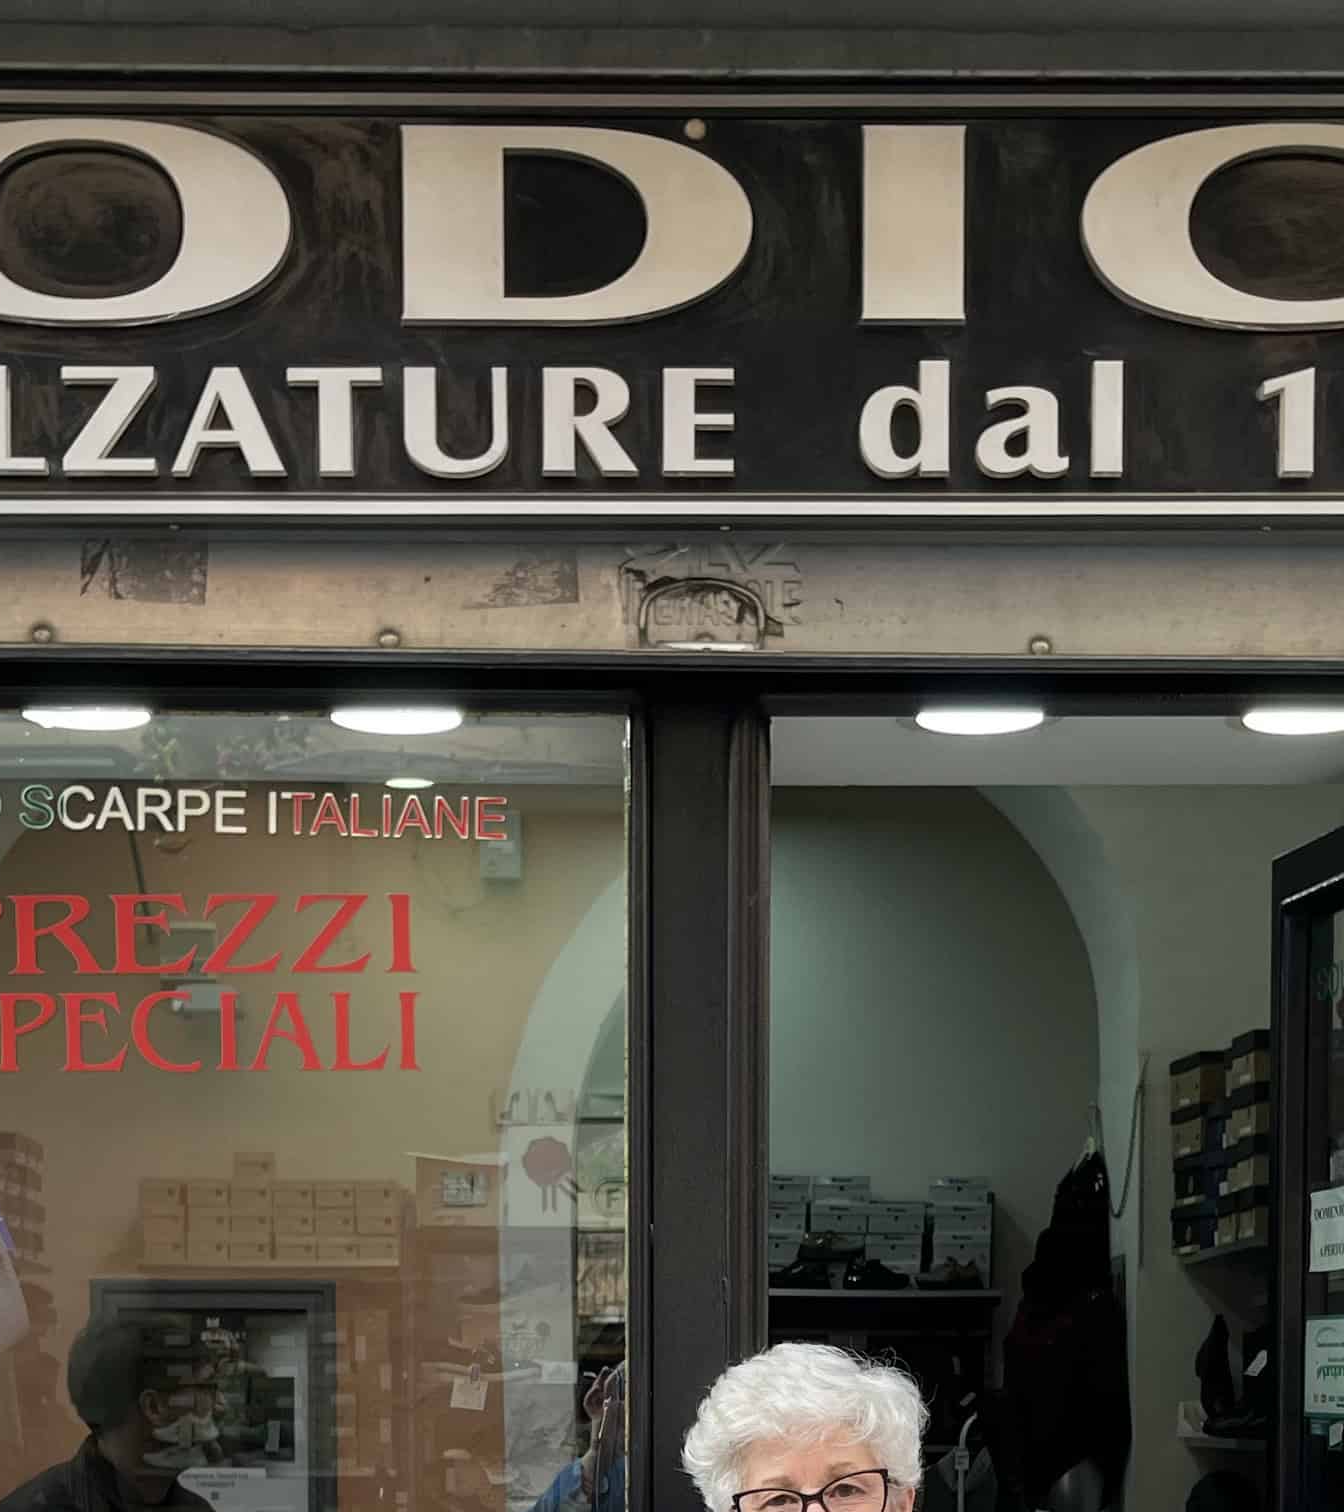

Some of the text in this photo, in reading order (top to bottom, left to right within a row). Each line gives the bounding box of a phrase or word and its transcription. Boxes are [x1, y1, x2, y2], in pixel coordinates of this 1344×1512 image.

[859, 360, 1124, 479] dal
[20, 784, 248, 834] SCARPE
[268, 791, 508, 841] ITALIANE
